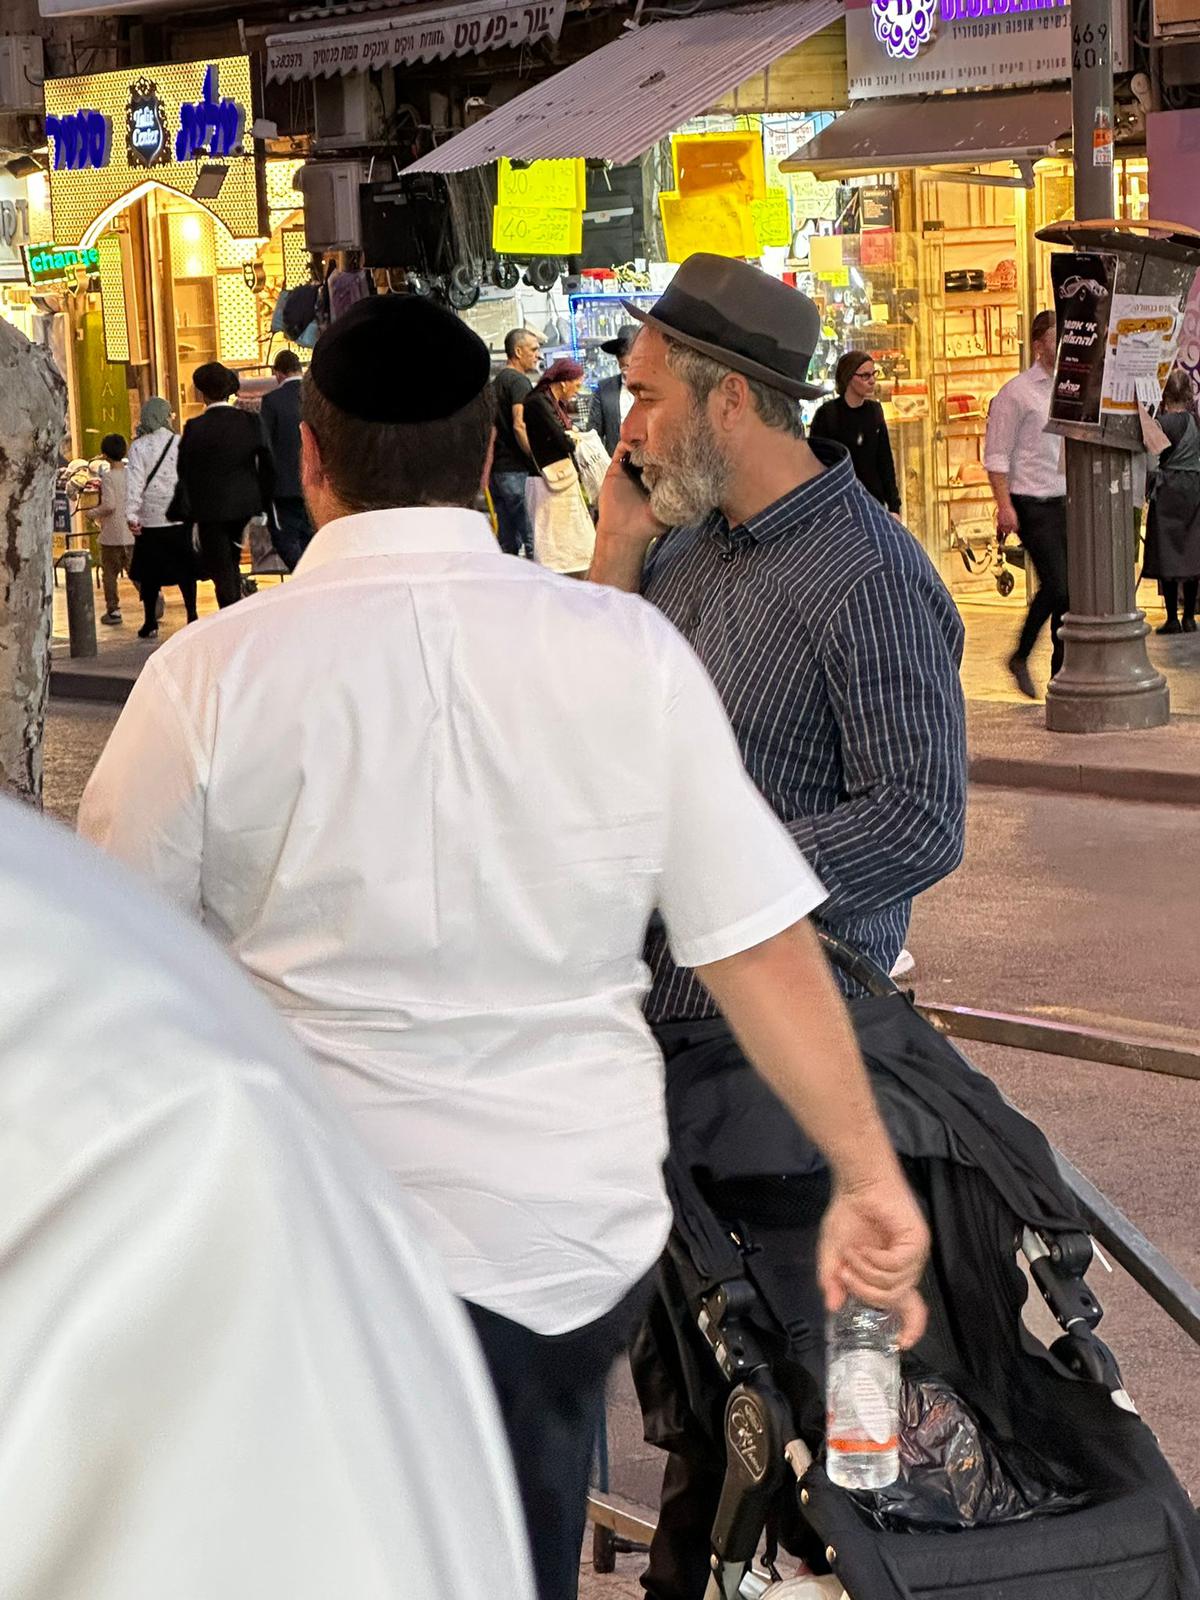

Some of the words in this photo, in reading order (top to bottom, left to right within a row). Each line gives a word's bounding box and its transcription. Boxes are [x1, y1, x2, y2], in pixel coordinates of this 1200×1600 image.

[1006, 17, 1034, 34] אופנה
[1039, 13, 1071, 29] כשיטי
[1073, 23, 1107, 46] 469
